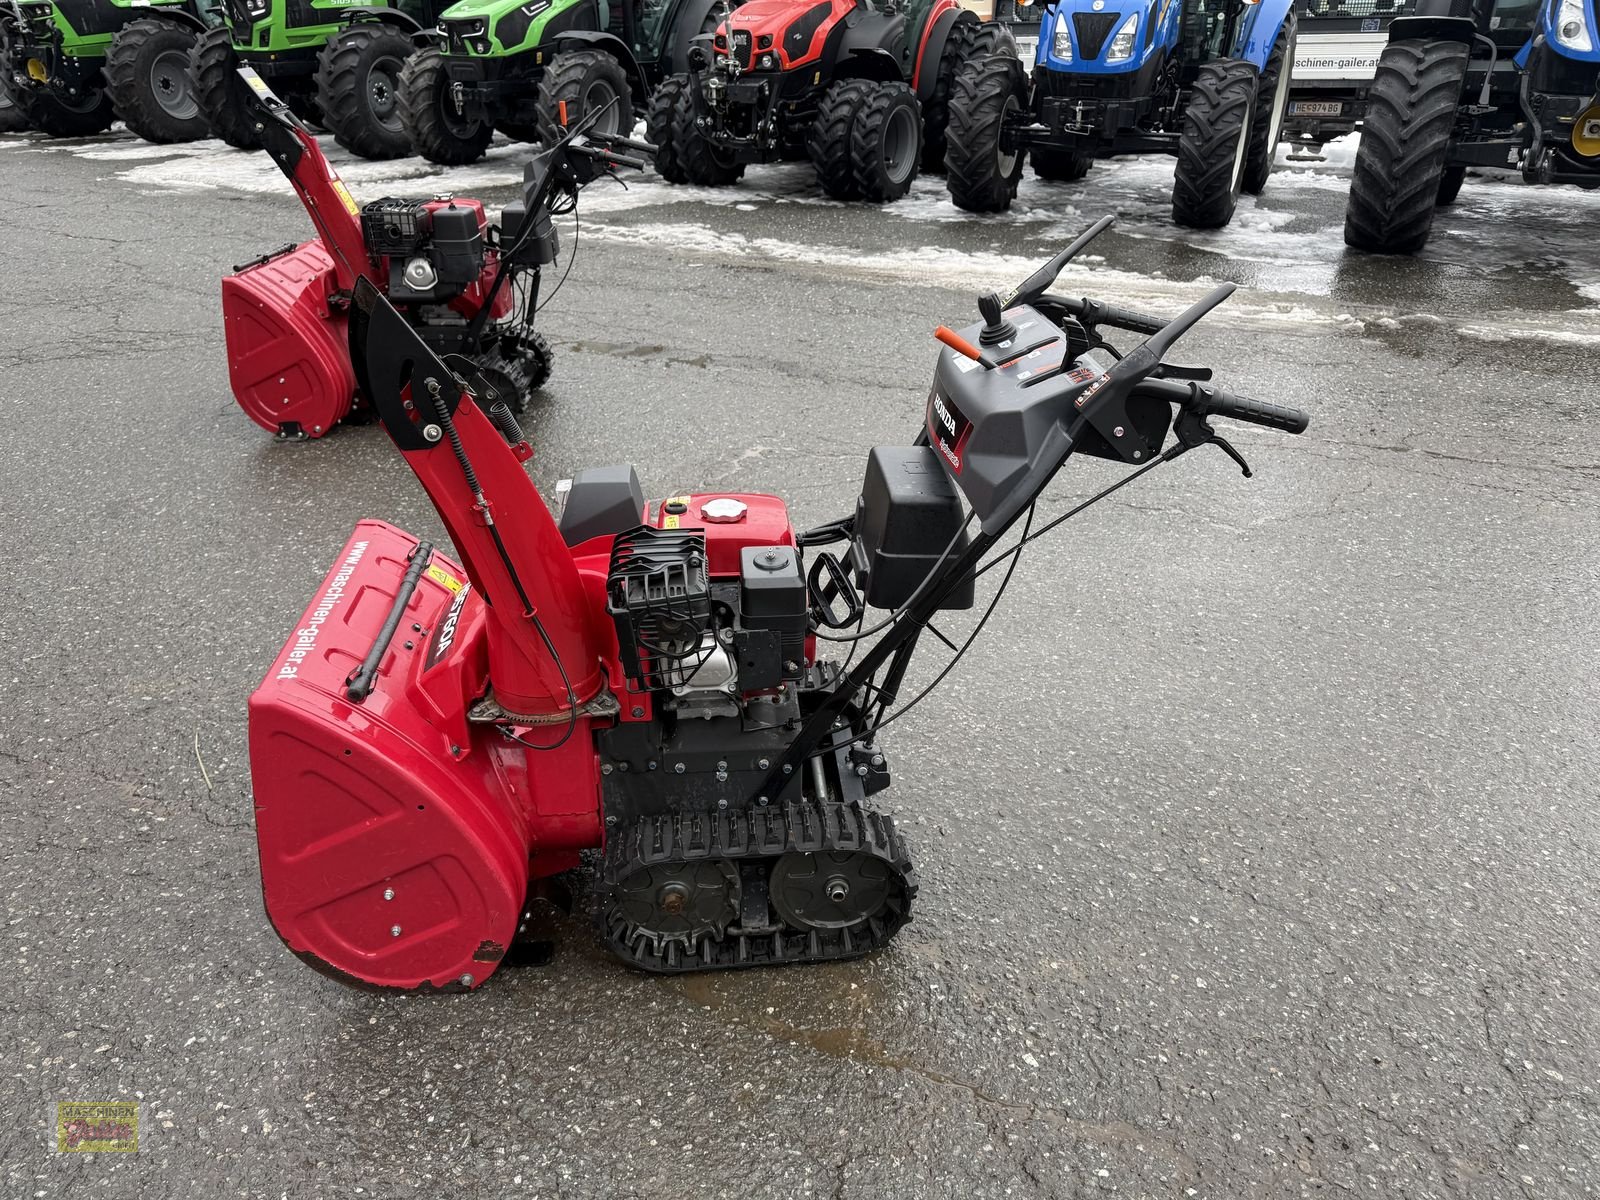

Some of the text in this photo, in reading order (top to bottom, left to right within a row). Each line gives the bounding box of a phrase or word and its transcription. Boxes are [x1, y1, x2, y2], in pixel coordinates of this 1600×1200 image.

[1294, 57, 1379, 69] schinen-gailer.at
[934, 393, 956, 437] HONDA
[276, 541, 369, 680] www.maschinen-gailer.at
